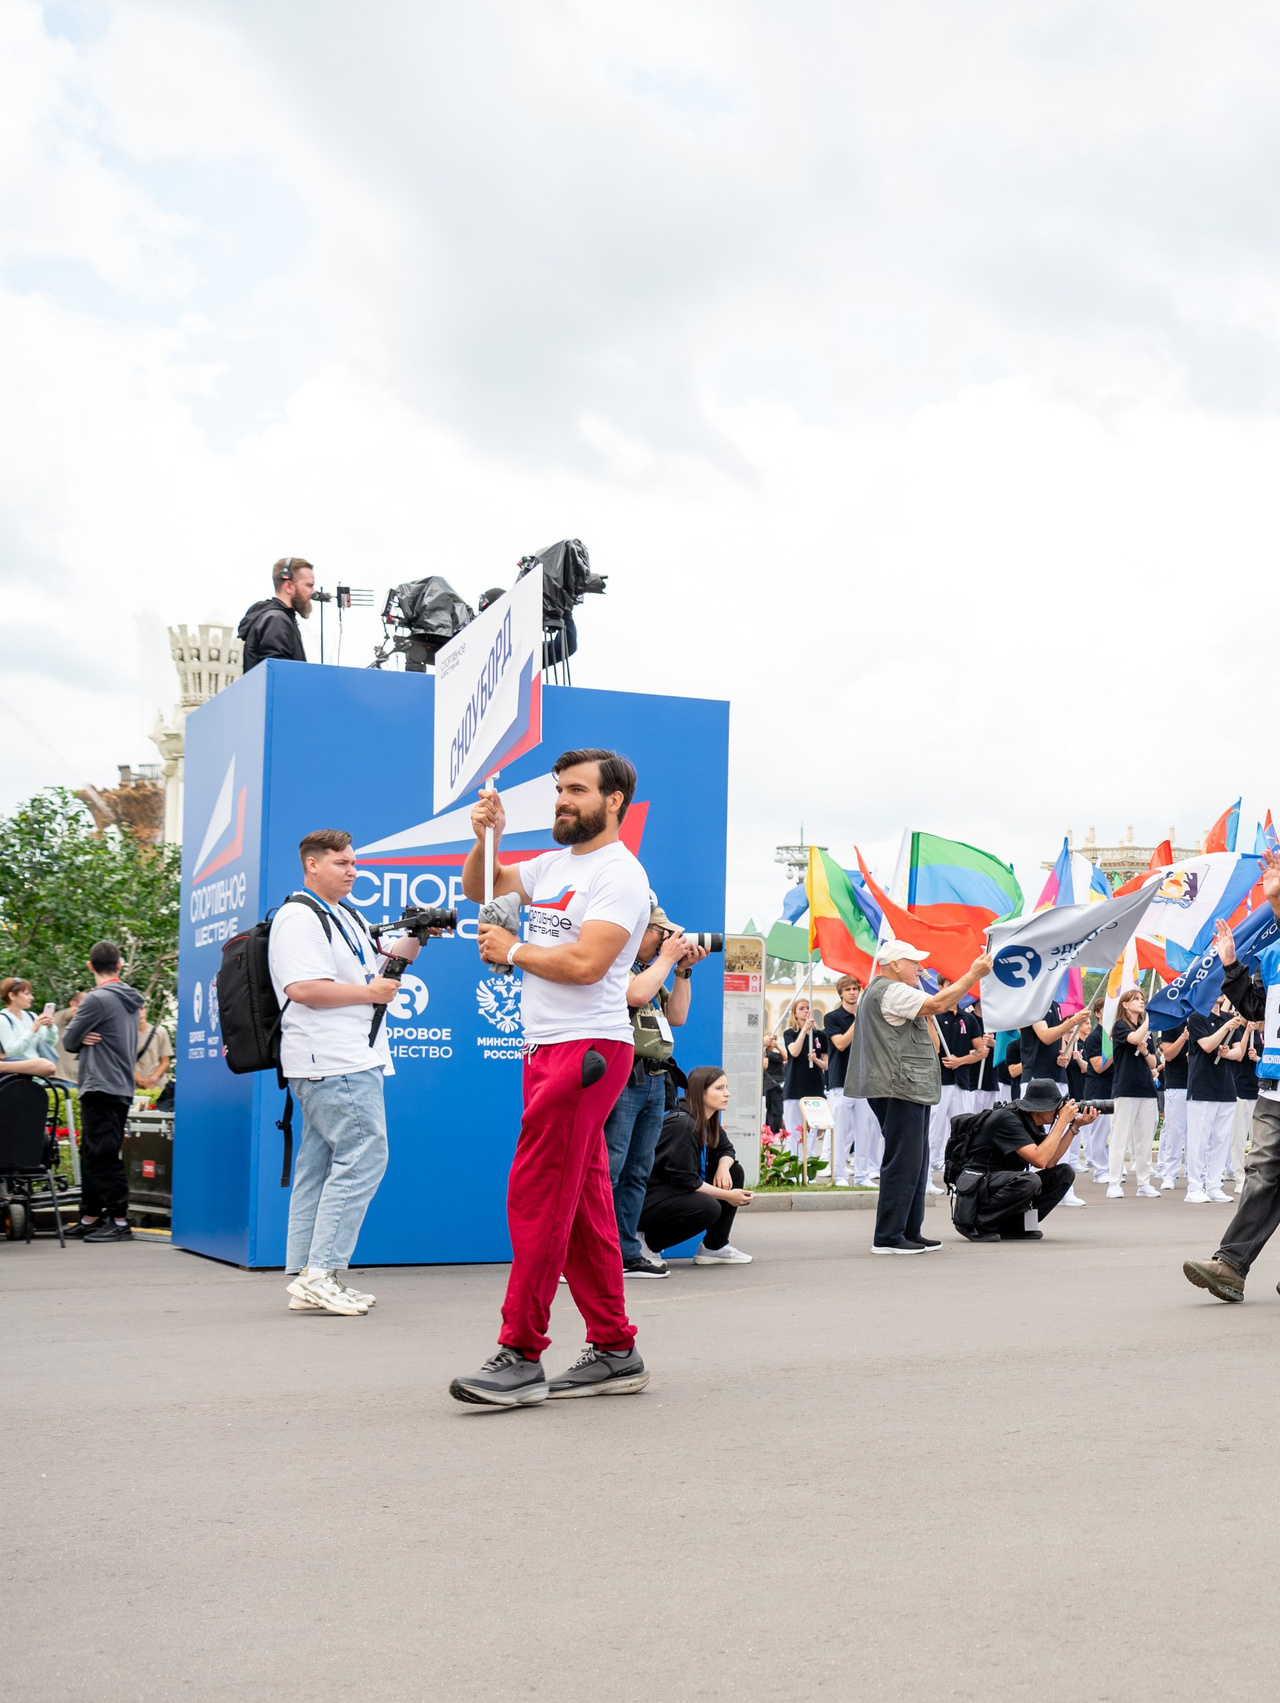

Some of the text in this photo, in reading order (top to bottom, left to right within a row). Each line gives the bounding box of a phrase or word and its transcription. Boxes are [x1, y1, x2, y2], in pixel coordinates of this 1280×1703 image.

[449, 605, 513, 790] СНОУБОРД
[385, 1027, 452, 1041] ОРОВОЕ
[476, 1037, 527, 1047] МИНСПО
[390, 1045, 453, 1059] ЧЕСТВО
